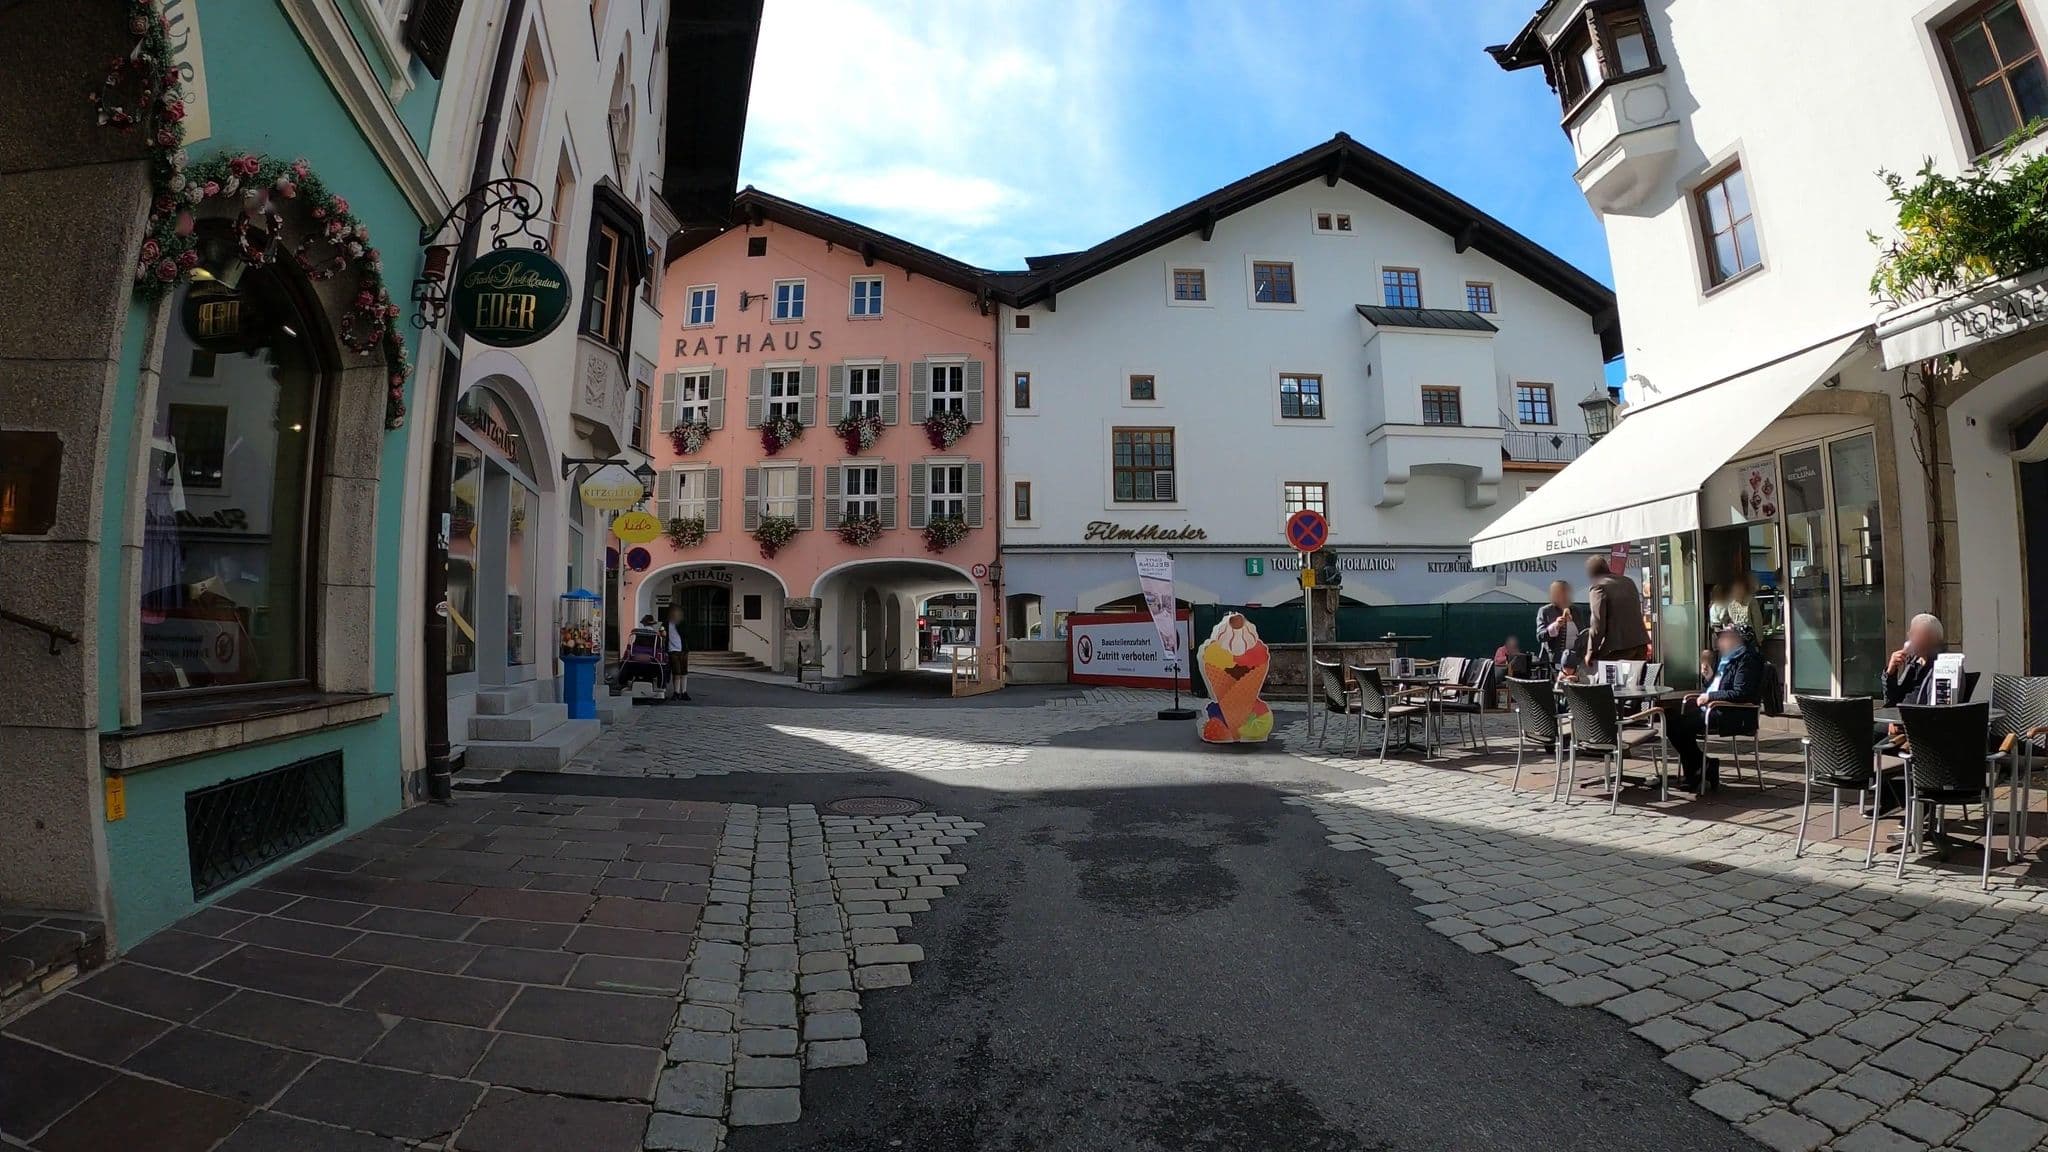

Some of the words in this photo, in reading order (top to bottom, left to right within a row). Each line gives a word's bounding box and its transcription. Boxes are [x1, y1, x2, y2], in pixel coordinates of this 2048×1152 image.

[475, 293, 536, 330] EDER
[674, 330, 823, 357] RATHAUS
[1084, 521, 1207, 541] Filmtheater
[1546, 536, 1588, 551] BELUNA
[1335, 558, 1396, 571] NFORMATION
[672, 569, 734, 584] RATHAUS
[1097, 651, 1119, 661] Zutritt
[1121, 651, 1157, 661] verboten!
